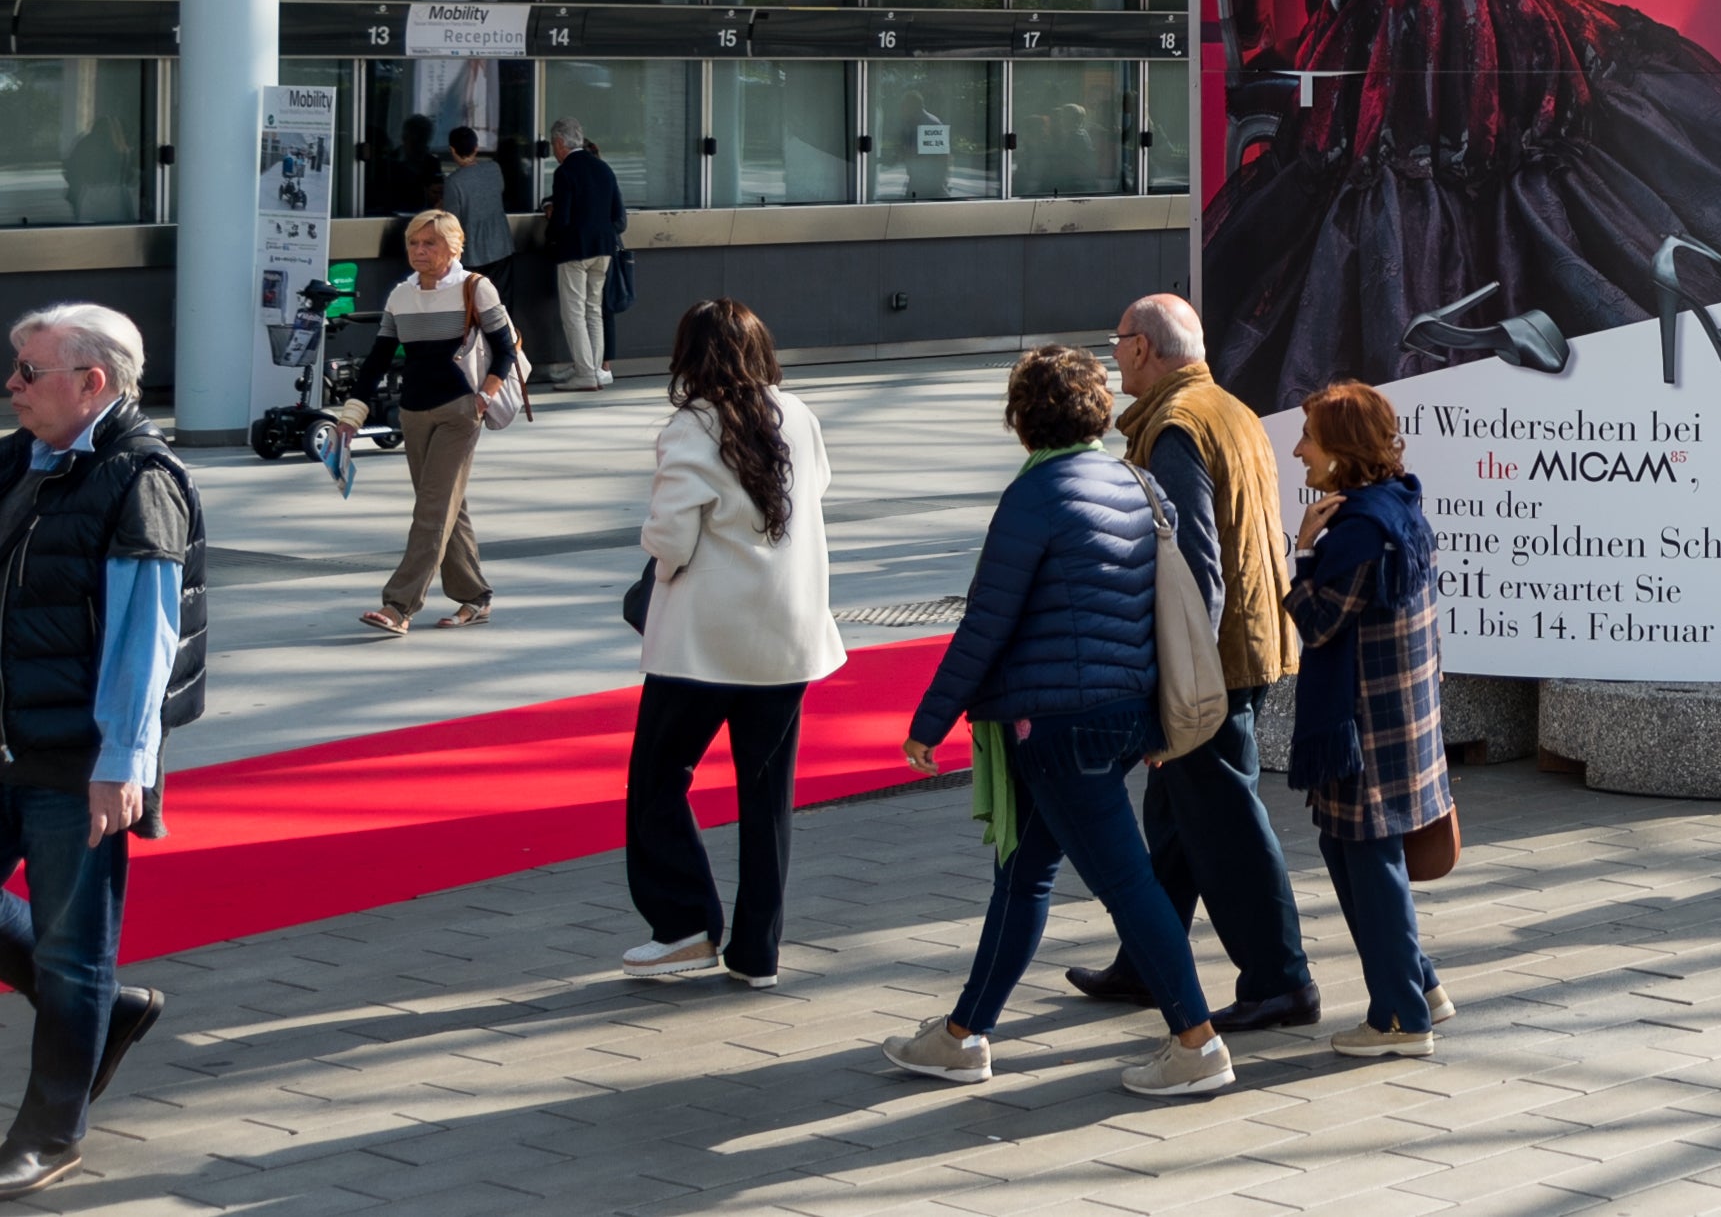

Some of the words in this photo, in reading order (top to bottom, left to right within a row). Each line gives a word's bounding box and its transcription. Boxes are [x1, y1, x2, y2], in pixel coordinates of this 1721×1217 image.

[429, 5, 489, 25] Mobility
[368, 26, 390, 45] 13
[444, 29, 523, 47] Reception
[549, 28, 570, 46] 14
[718, 29, 737, 47] 15
[878, 30, 896, 49] 16
[1023, 32, 1040, 49] 17
[1159, 32, 1176, 50] 18
[289, 90, 333, 113] Mobility
[1397, 404, 1425, 435] uf
[1432, 405, 1639, 442] Wiedersehen
[1650, 410, 1703, 443] bei
[1476, 451, 1519, 480] the
[1298, 487, 1323, 505] un
[1435, 496, 1486, 517] neu
[1495, 490, 1543, 519] der
[1435, 530, 1500, 554] erne
[1511, 524, 1648, 567] goldnen
[1437, 558, 1492, 599] eit
[1499, 579, 1624, 603] erwartet
[1635, 573, 1682, 604] Sie
[1478, 608, 1519, 639] bis
[1531, 610, 1577, 640] 14.
[1587, 611, 1715, 644] Februar
